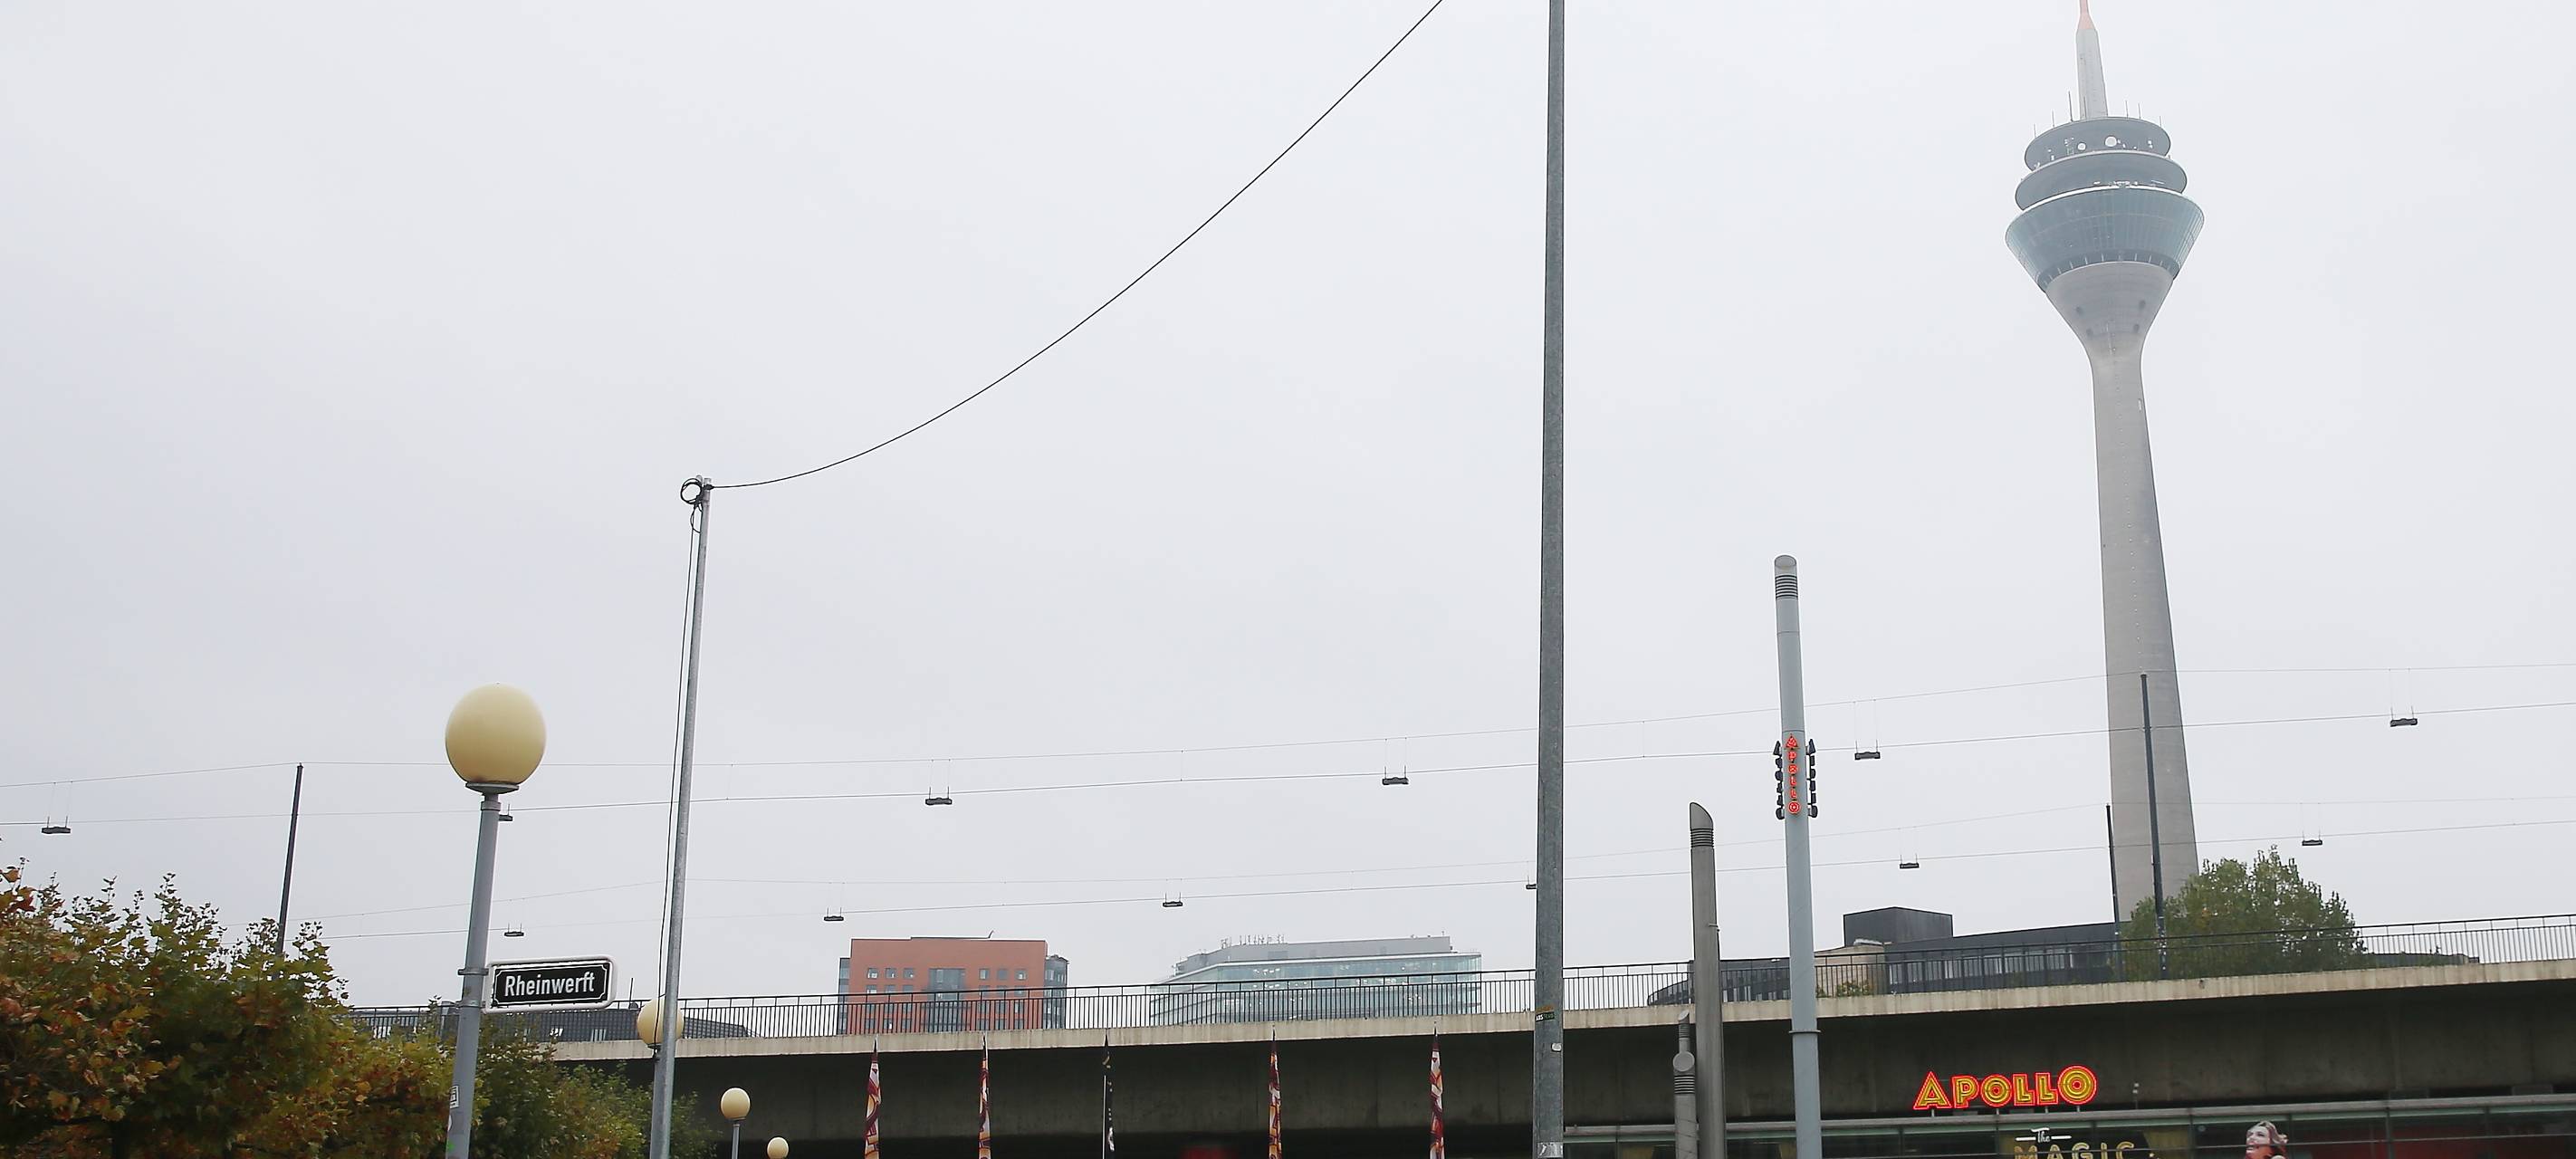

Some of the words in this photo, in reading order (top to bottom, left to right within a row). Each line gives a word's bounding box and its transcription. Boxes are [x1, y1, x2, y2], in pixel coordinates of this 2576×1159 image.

[504, 971, 595, 997] Rheinwerft
[1913, 1066, 2097, 1110] APOLLO
[2031, 1127, 2051, 1143] The
